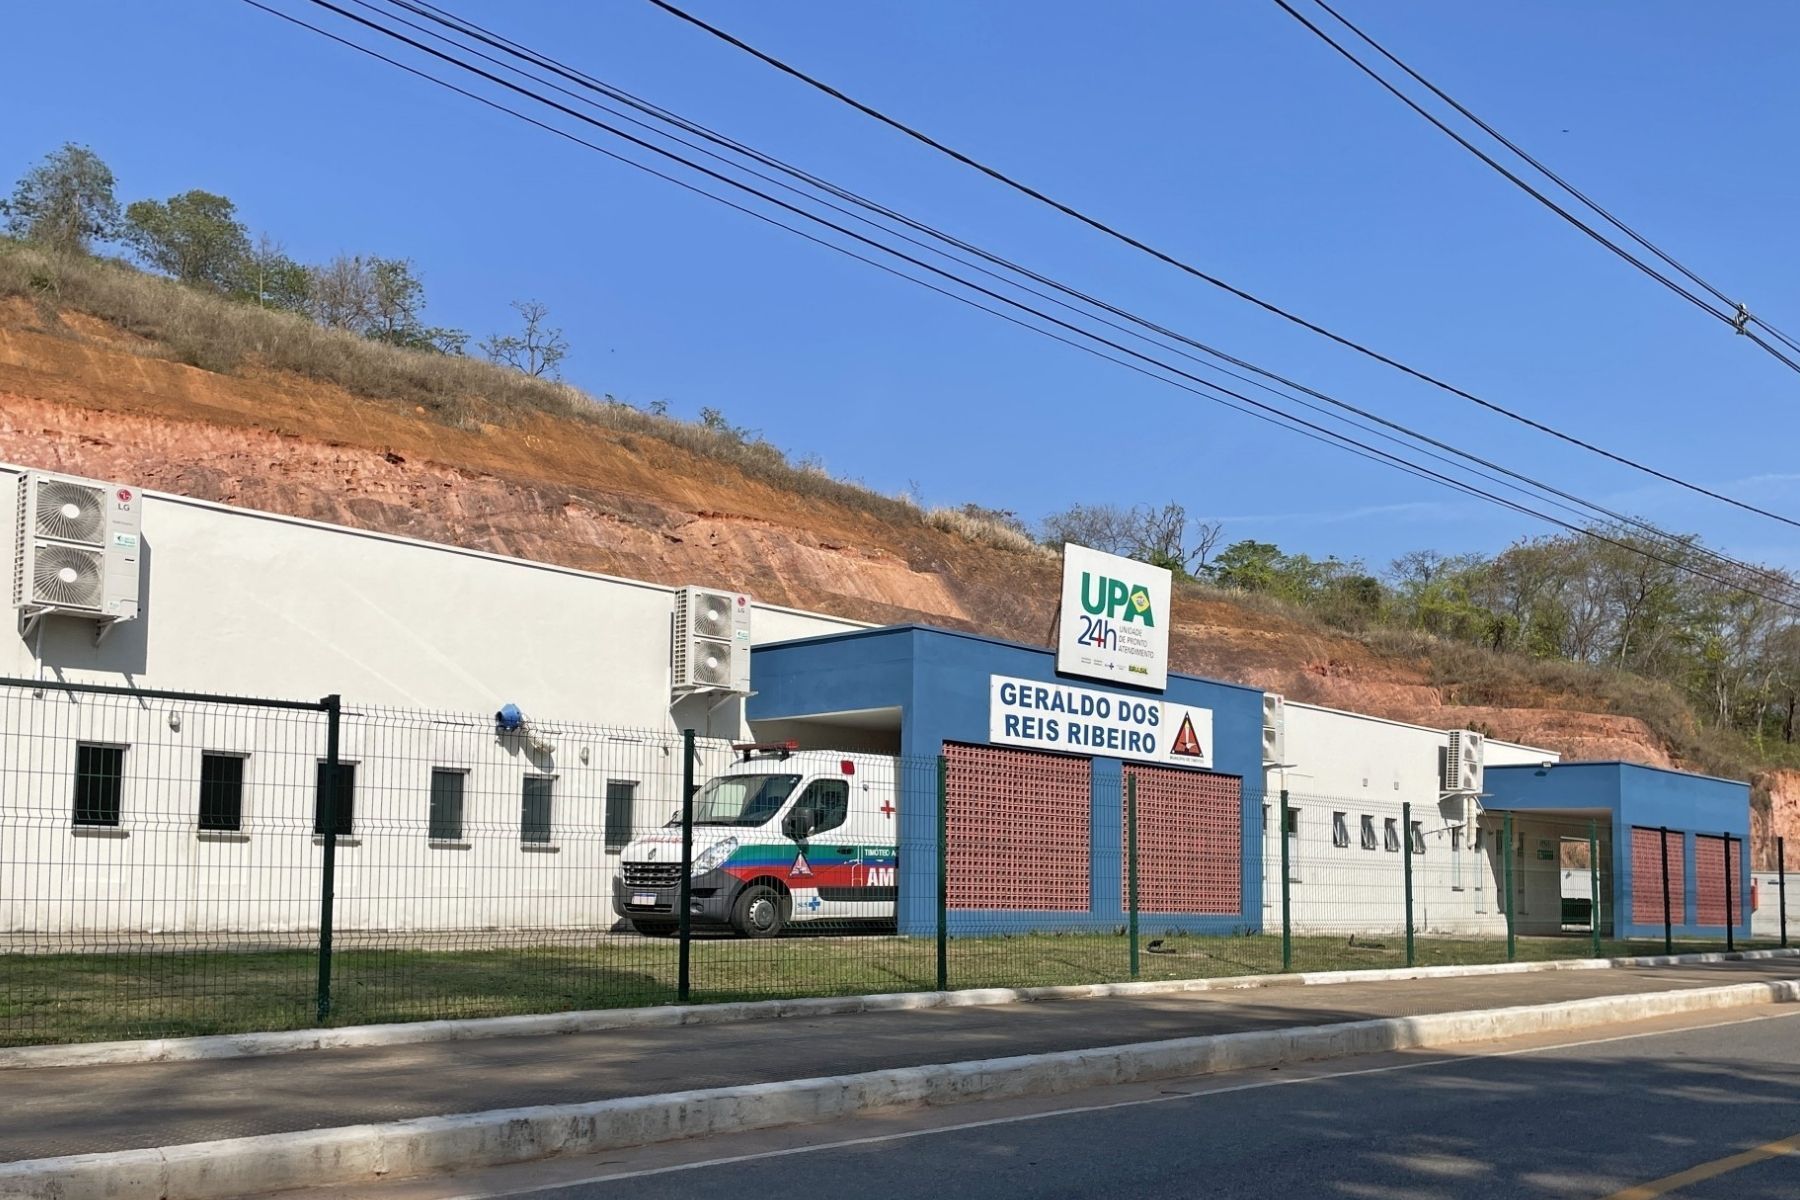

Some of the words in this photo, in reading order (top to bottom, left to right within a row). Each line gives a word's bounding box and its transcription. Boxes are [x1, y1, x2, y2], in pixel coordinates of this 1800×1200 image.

[118, 503, 130, 511] LG
[1081, 571, 1155, 628] UPA
[1077, 615, 1117, 651] 24h
[1118, 635, 1126, 643] DE
[1127, 637, 1148, 648] PRONTO
[1118, 645, 1154, 659] ATENDIMENTO
[1000, 682, 1110, 719] GERALDO
[1118, 700, 1159, 727] DOS
[1004, 713, 1059, 742] REIS
[1067, 722, 1156, 754] RIBEIRO
